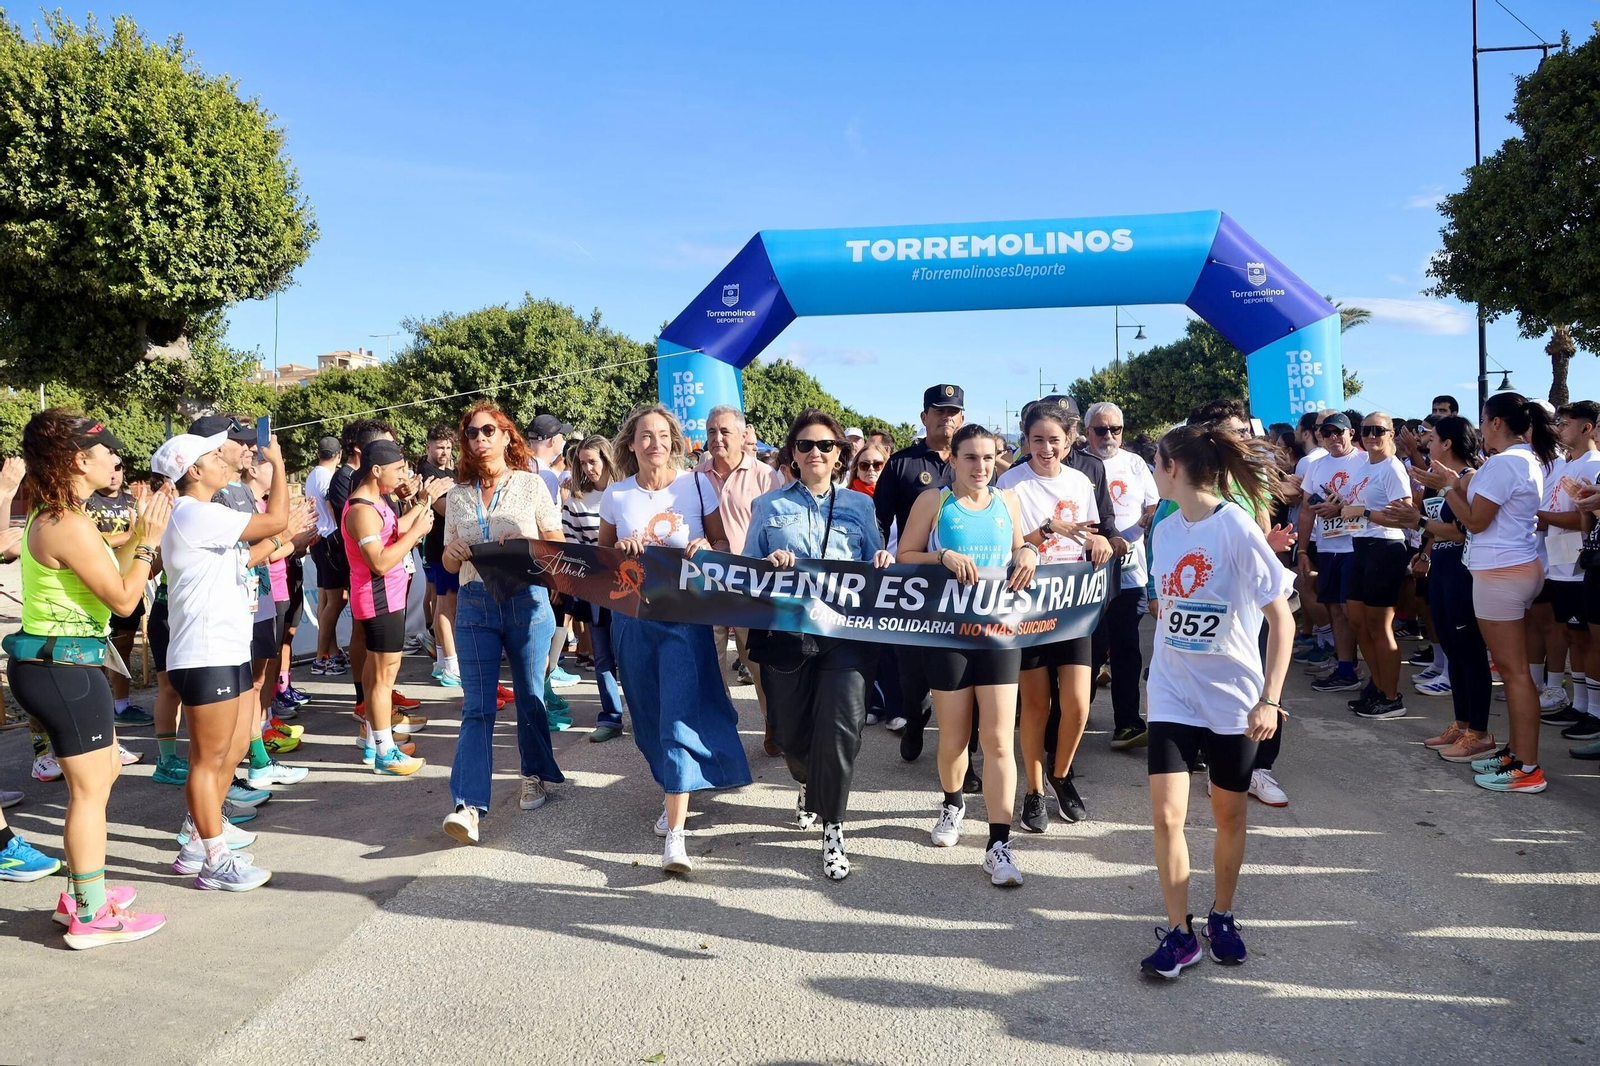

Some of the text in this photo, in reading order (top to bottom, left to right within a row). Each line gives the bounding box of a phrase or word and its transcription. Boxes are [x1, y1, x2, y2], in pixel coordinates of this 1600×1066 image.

[845, 228, 1134, 263] TORREMOLINOS
[911, 262, 1066, 280] #TorremolinosesDeporte
[1230, 288, 1286, 298] Torremolinos
[706, 309, 756, 317] Torremolinos
[1285, 349, 1312, 363] TO
[1287, 362, 1323, 376] RRE
[672, 370, 694, 384] TO
[1288, 375, 1315, 389] MO
[673, 382, 705, 396] RRE
[1289, 388, 1306, 401] LI
[674, 395, 696, 408] MO
[1290, 400, 1326, 414] NOS
[679, 558, 867, 609] PREVENIR
[874, 575, 929, 611] ES
[937, 574, 1075, 616] NUESTRA
[809, 607, 875, 630] CARRERA
[878, 616, 956, 635] SOLIDARIA
[959, 622, 982, 637] NO
[1017, 617, 1059, 636] SUICIDIOS
[1168, 610, 1220, 638] 952
